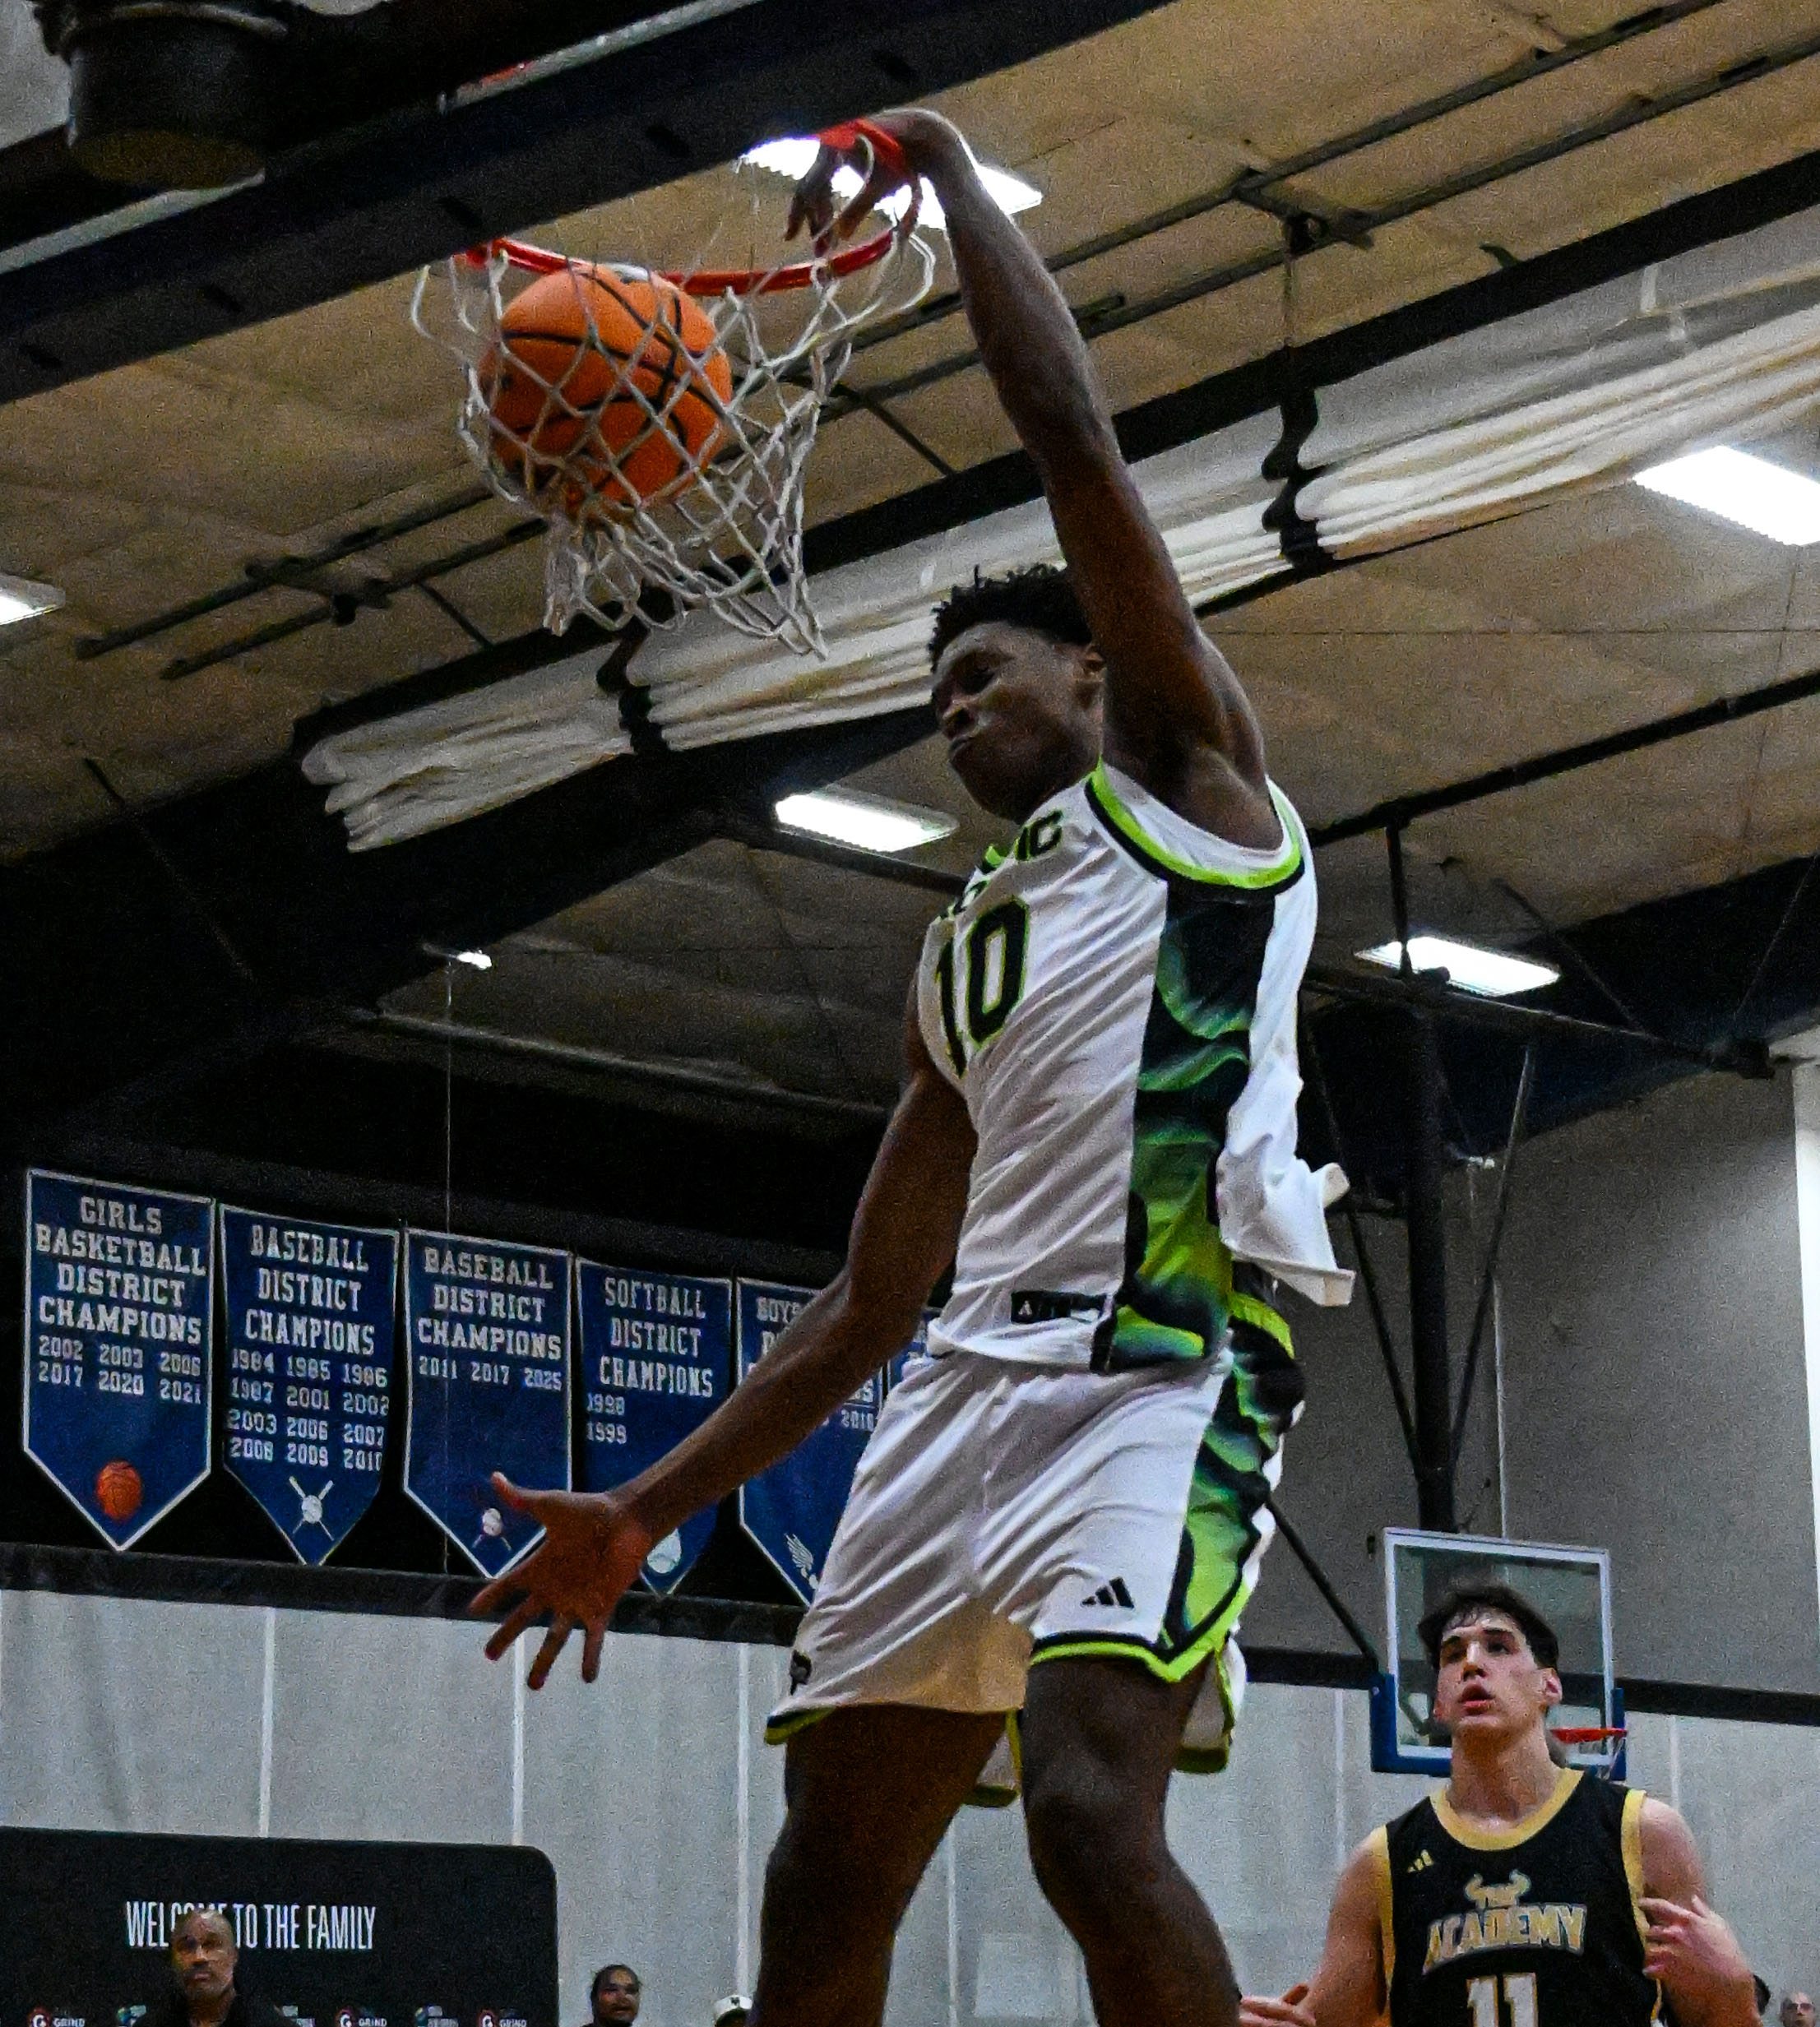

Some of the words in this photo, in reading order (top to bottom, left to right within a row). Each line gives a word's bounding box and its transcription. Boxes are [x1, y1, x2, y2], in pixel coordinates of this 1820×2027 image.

[934, 898, 1029, 1080] 10
[81, 1196, 163, 1235] GIRLS
[35, 1223, 206, 1275] BASKETBALL
[251, 1224, 369, 1273] BASEBALL
[424, 1247, 553, 1289] BASEBALL
[58, 1262, 185, 1307] DISTRICT
[257, 1267, 362, 1312] DISTRICT
[433, 1284, 546, 1323] DISTRICT
[604, 1276, 706, 1320] SOFTBALL
[39, 1295, 201, 1344] CHAMPIONS
[245, 1308, 375, 1355] CHAMPIONS
[418, 1317, 561, 1360] CHAMPIONS
[611, 1317, 702, 1358] DISTRICT
[39, 1335, 83, 1361] 2002
[99, 1344, 143, 1369] 2003
[231, 1348, 275, 1374] 1984
[287, 1355, 331, 1381] 1985
[419, 1355, 458, 1380] 2011
[470, 1361, 510, 1385] 2017
[39, 1361, 83, 1388] 2017
[98, 1370, 144, 1396] 2020
[160, 1378, 201, 1405] 2021
[230, 1377, 275, 1404] 1987
[286, 1385, 330, 1410] 2001
[600, 1355, 714, 1398] CHAMPIONS
[227, 1408, 277, 1435] 2003
[344, 1423, 385, 1449] 2007
[586, 1420, 627, 1445] 1999
[287, 1442, 329, 1467] 2009
[126, 1901, 227, 1947] WELC
[233, 1903, 258, 1949] TO
[263, 1903, 301, 1949] THE
[307, 1904, 377, 1950] FAMILY
[1423, 1902, 1587, 1974] ACADEMY
